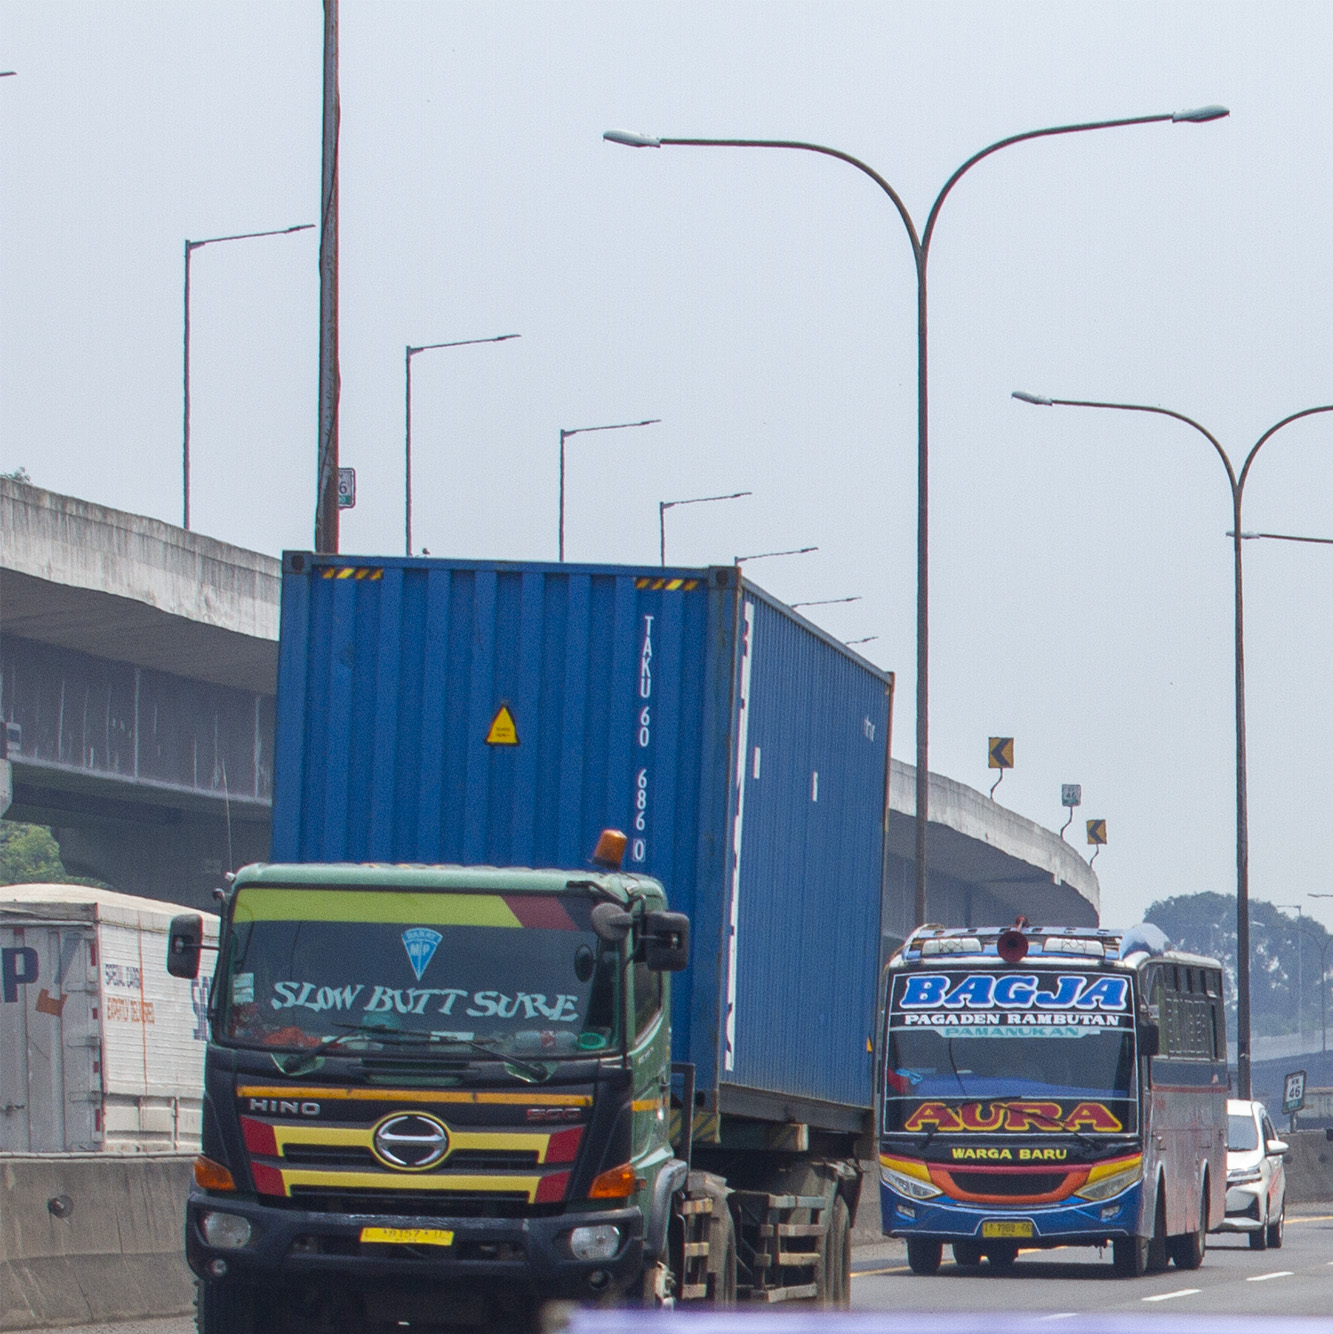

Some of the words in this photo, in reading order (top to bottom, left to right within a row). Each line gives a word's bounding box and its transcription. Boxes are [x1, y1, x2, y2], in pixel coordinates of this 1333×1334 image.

[640, 615, 655, 699] TAKU
[271, 980, 365, 1013] SLOW
[363, 985, 468, 1015] BUTT
[466, 990, 579, 1022] SURE
[900, 974, 1128, 1011] BAGJA
[904, 1013, 1000, 1025] PAGADEN
[1007, 1013, 1120, 1026] RAMBUTAN
[944, 1026, 1080, 1037] PAMANUKAN
[249, 1097, 322, 1116] HINO
[904, 1101, 1123, 1132] AURA
[952, 1148, 1013, 1160] WARGA
[1019, 1148, 1068, 1160] BARU
